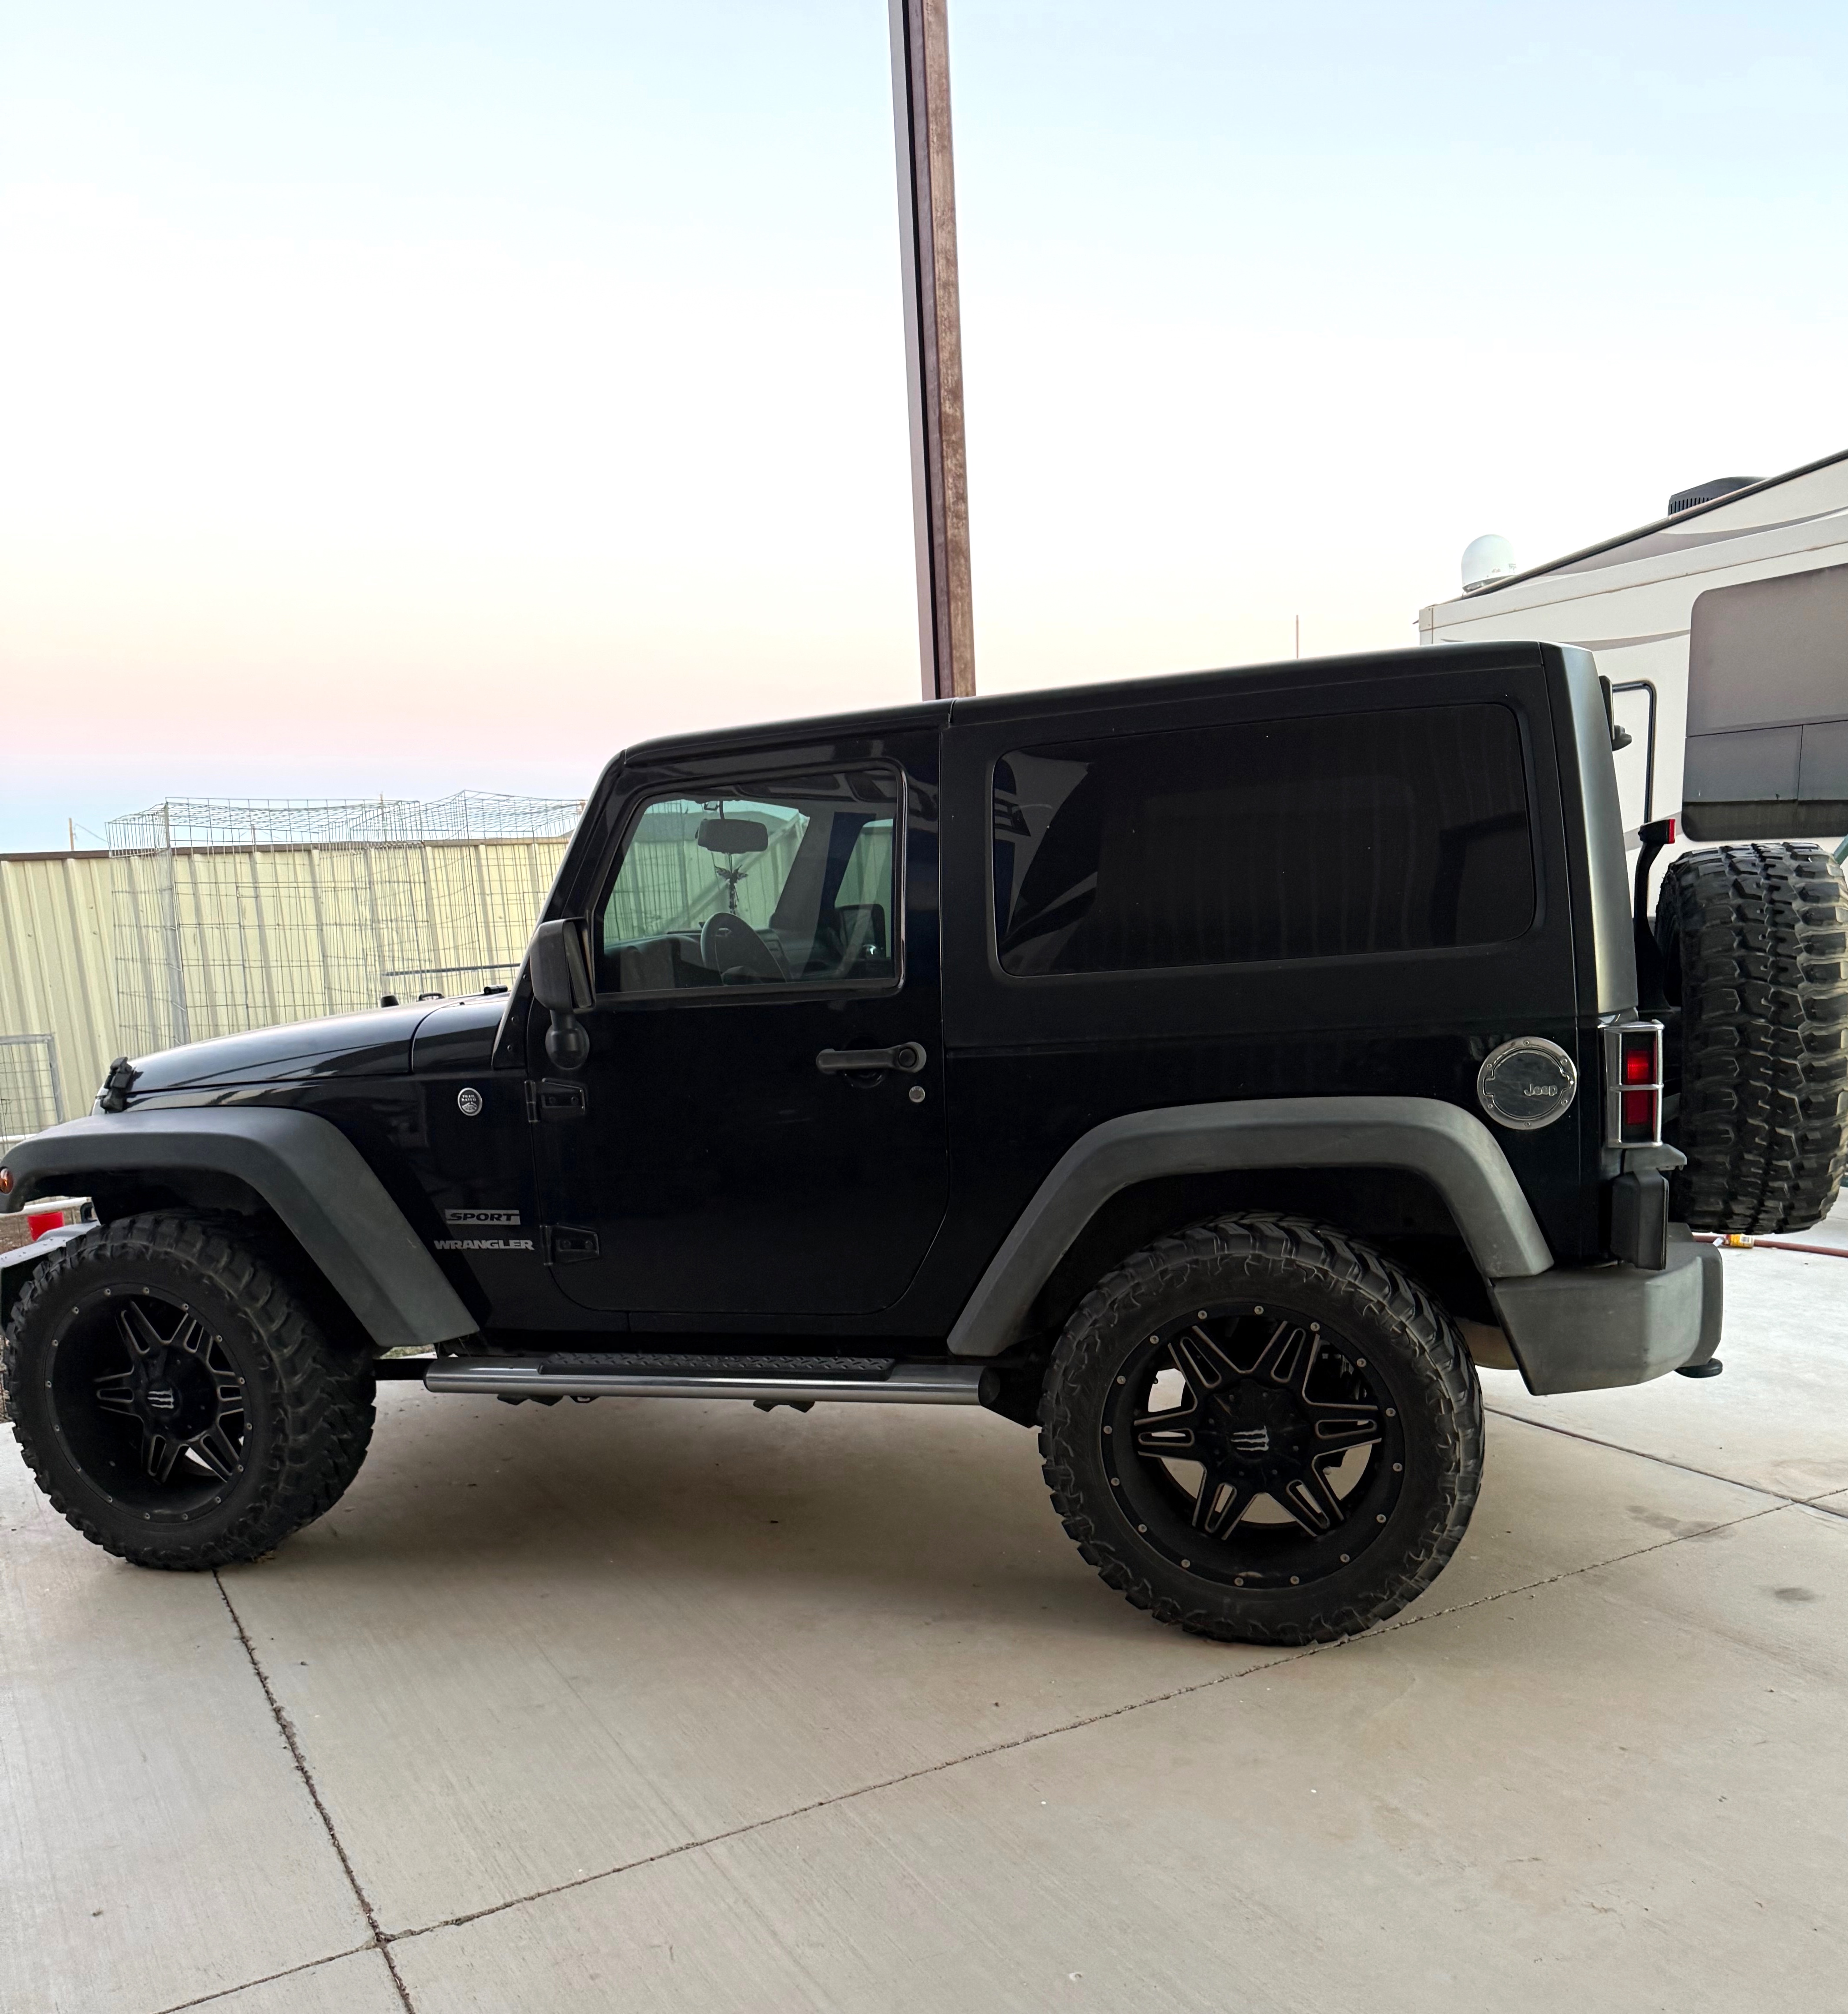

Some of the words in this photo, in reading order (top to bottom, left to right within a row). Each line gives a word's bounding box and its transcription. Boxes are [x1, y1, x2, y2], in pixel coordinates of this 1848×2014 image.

[1524, 1084, 1558, 1096] Jeep
[447, 1213, 520, 1221] SPORT
[434, 1240, 535, 1250] WRANGLER
